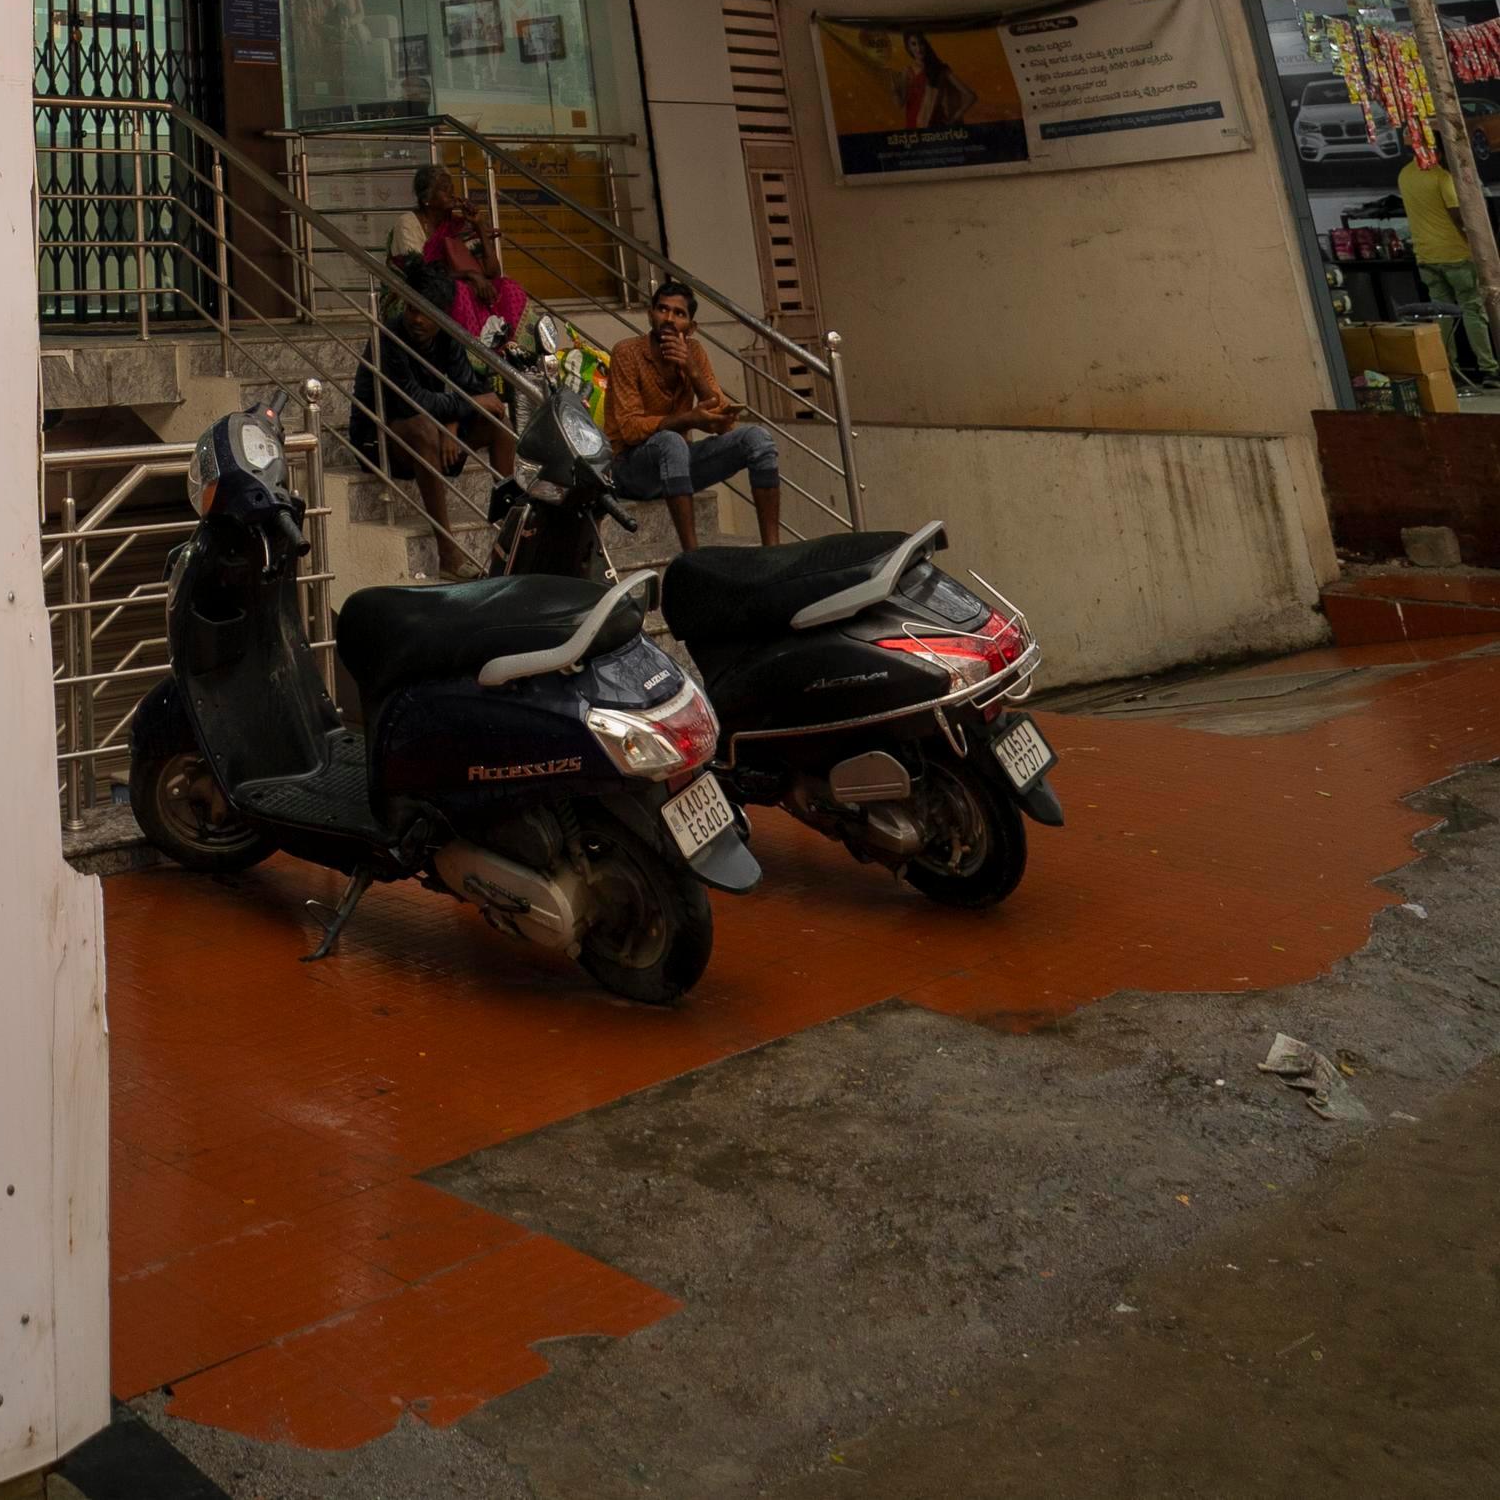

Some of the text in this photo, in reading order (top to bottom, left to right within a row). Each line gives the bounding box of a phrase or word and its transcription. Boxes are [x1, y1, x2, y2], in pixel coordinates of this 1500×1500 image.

[643, 669, 672, 691] SUZUKI
[1002, 723, 1032, 762] KA51J
[1014, 743, 1045, 781] C7377
[687, 801, 730, 846] E6403
